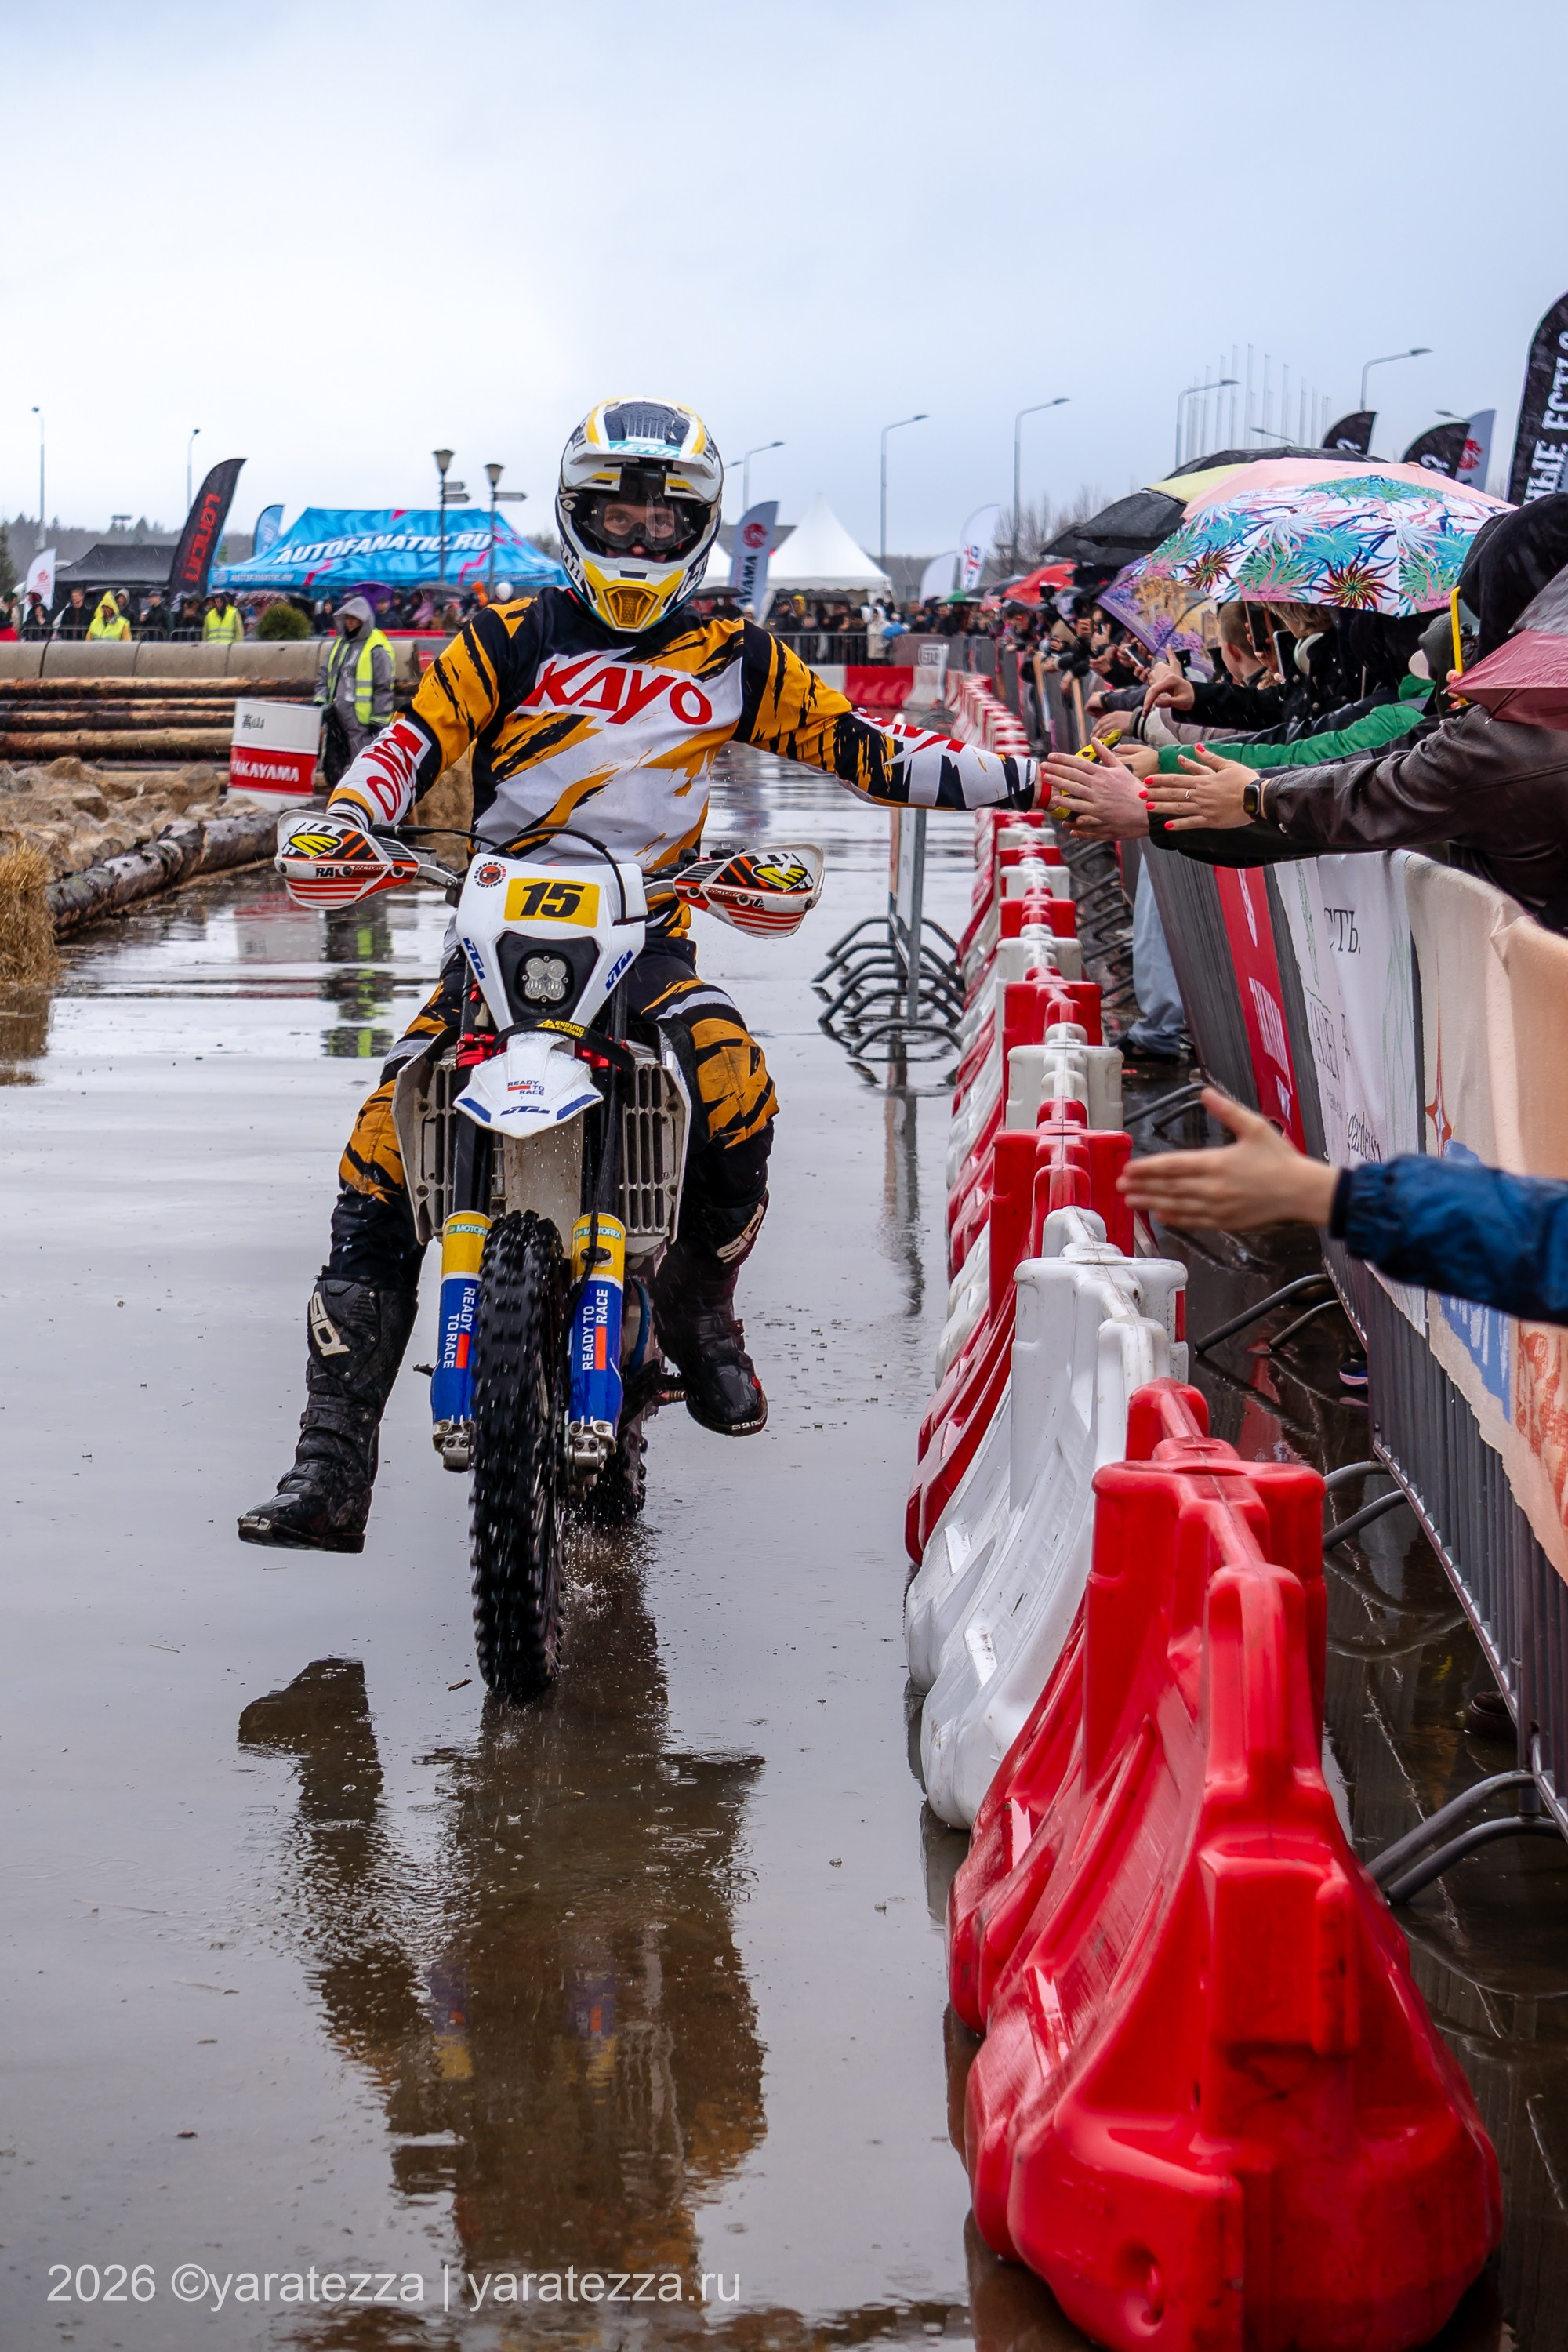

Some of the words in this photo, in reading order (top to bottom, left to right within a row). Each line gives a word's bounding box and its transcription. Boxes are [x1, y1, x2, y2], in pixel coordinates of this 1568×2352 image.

[270, 532, 493, 565] AUTOFANATIC.RU
[519, 654, 713, 726] KAYO
[519, 881, 586, 918] 15
[463, 937, 486, 980] KTM
[605, 949, 633, 992] KTM
[554, 1020, 585, 1034] ENDURO
[555, 1025, 583, 1039] ELEMENT
[499, 1105, 550, 1116] KTM
[456, 1224, 488, 1236] MOTOR
[583, 1227, 622, 1240] MTOREX
[447, 1312, 460, 1331] TO
[460, 1287, 476, 1332] READY
[583, 1305, 595, 1325] TO
[596, 1288, 608, 1324] RACE
[443, 1333, 457, 1369] RACE
[582, 1327, 594, 1370] READY
